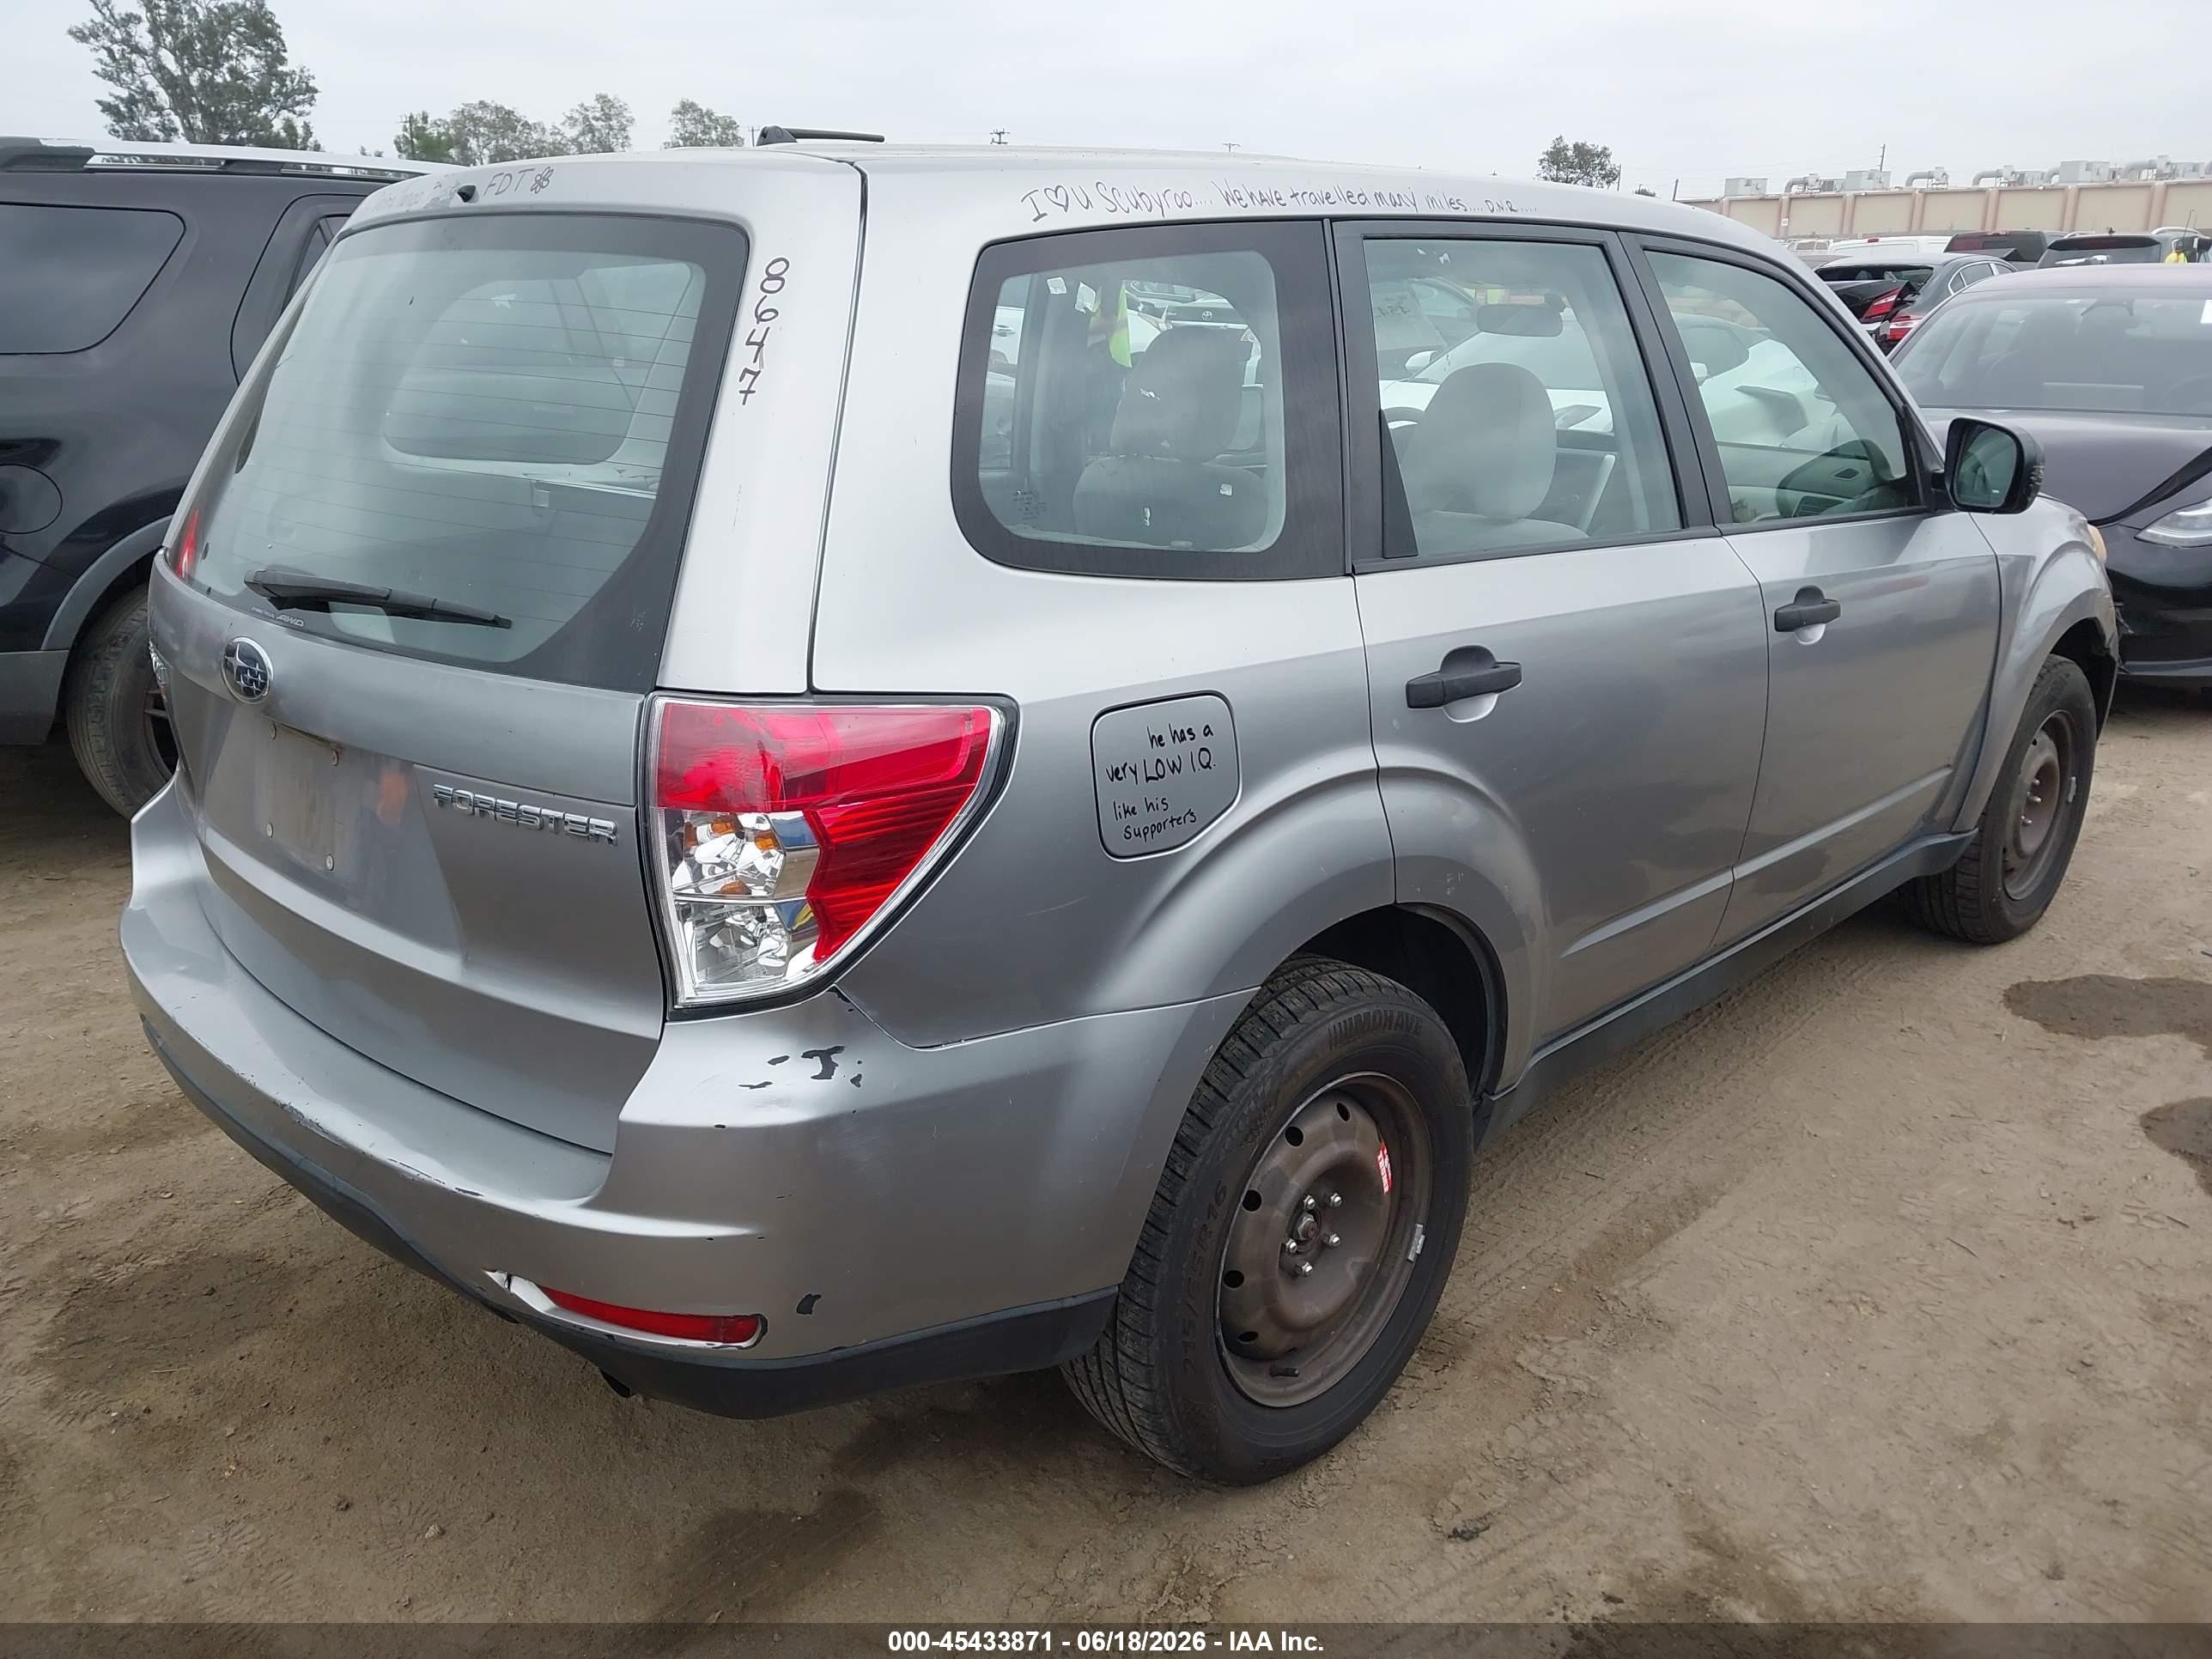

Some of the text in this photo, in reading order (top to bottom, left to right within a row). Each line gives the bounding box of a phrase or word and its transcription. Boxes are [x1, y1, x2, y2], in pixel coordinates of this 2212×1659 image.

[483, 167, 536, 197] FDT
[738, 257, 791, 406] 8647
[1146, 723, 1214, 750] he has a
[1105, 762, 1139, 786] very
[1143, 754, 1182, 783] LOW
[433, 783, 618, 846] FORESTER
[1113, 796, 1170, 822] like his
